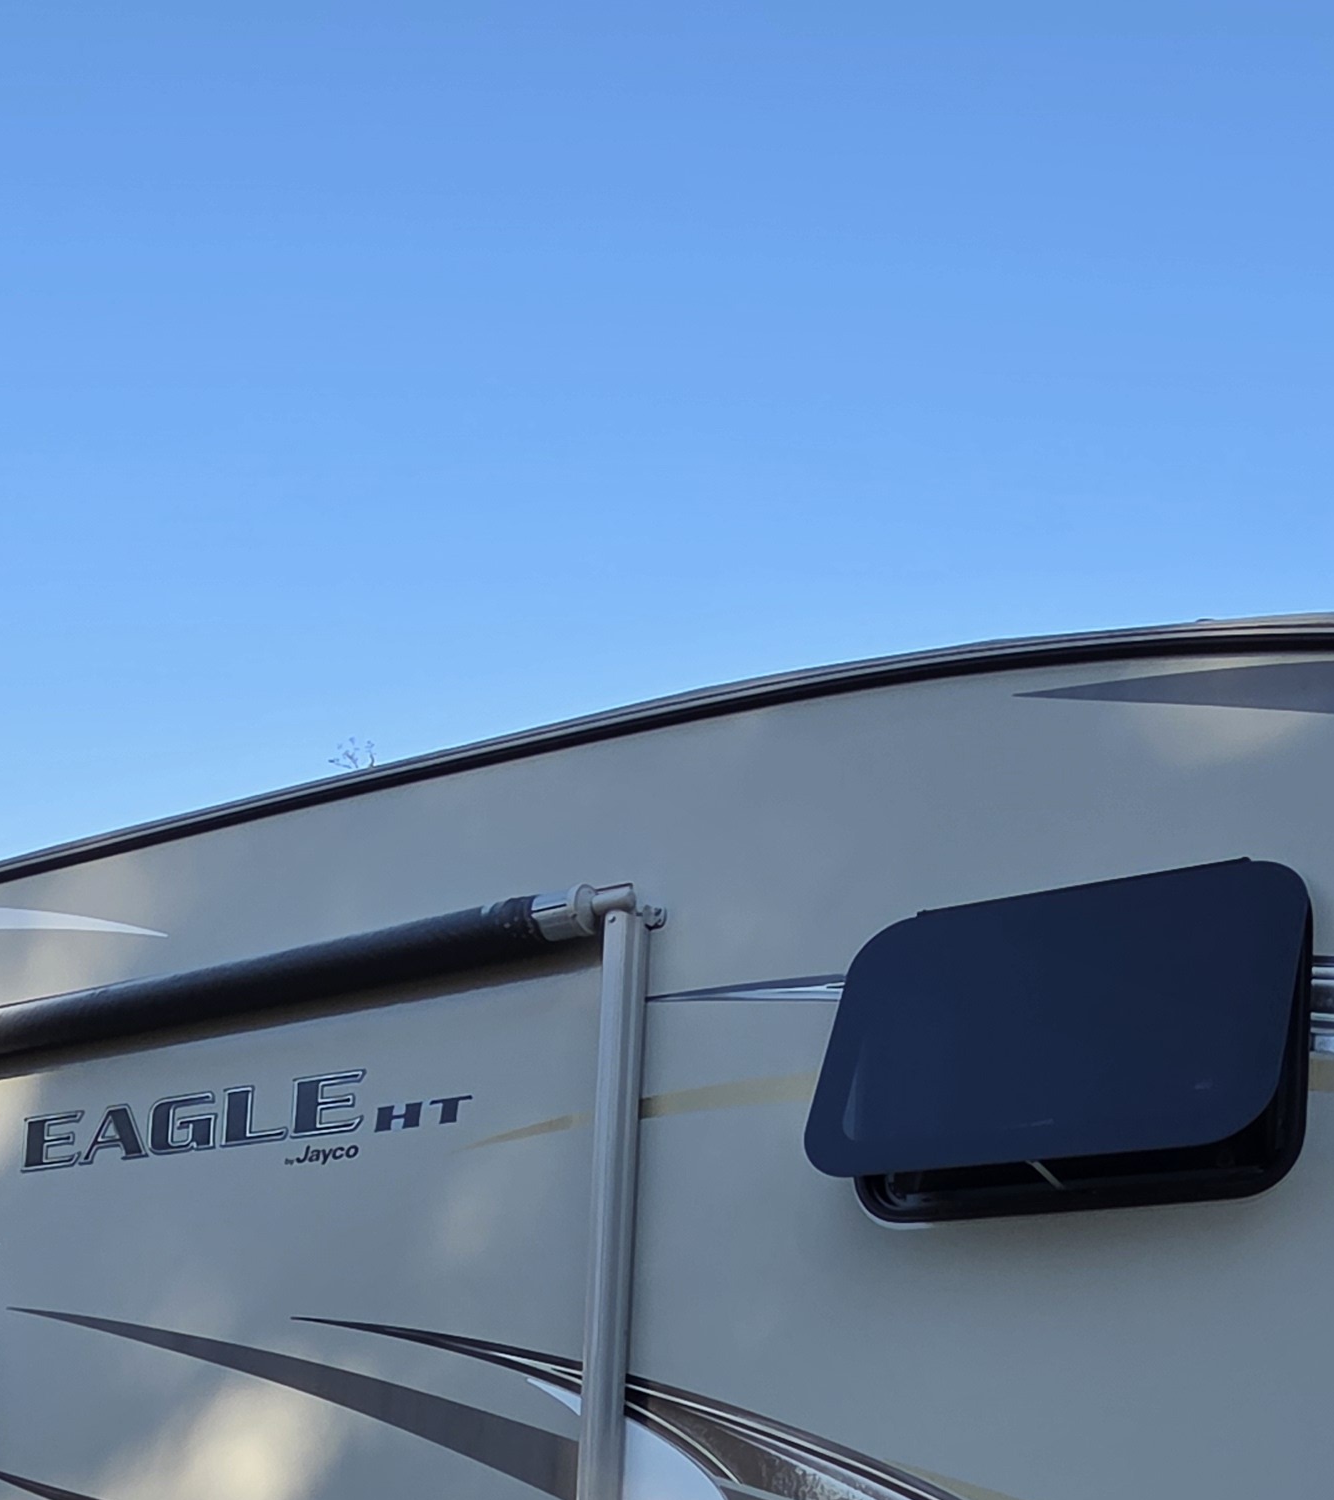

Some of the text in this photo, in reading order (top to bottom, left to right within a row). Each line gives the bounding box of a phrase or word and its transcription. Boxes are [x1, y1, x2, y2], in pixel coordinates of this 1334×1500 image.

[20, 1068, 473, 1173] EAGLE HT
[295, 1145, 359, 1166] Jayco
